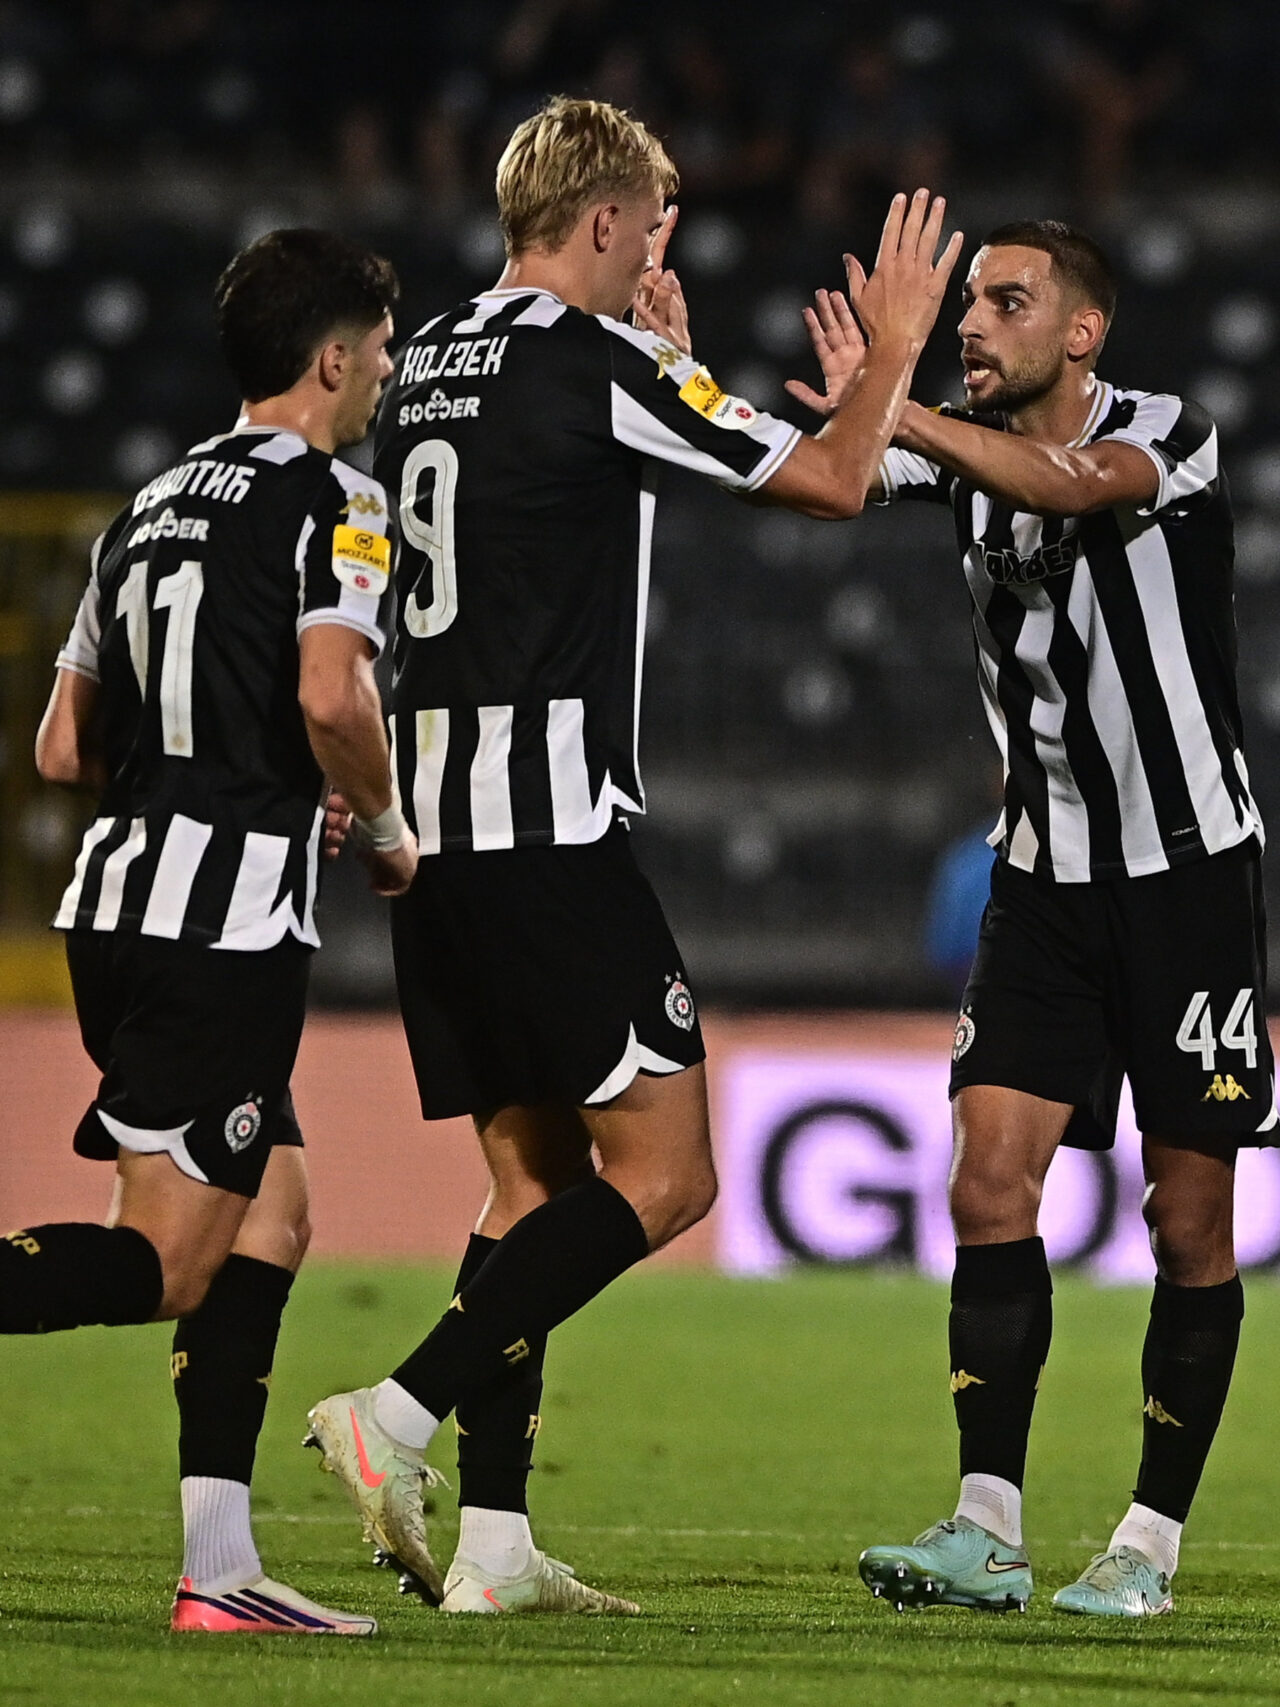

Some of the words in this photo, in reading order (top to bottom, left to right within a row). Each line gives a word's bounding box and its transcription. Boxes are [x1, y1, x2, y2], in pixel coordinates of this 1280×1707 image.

[398, 389, 480, 426] SOCCER
[127, 508, 210, 549] SOCCER
[399, 439, 459, 639] 9
[115, 560, 204, 758] 11
[1176, 988, 1258, 1071] 44
